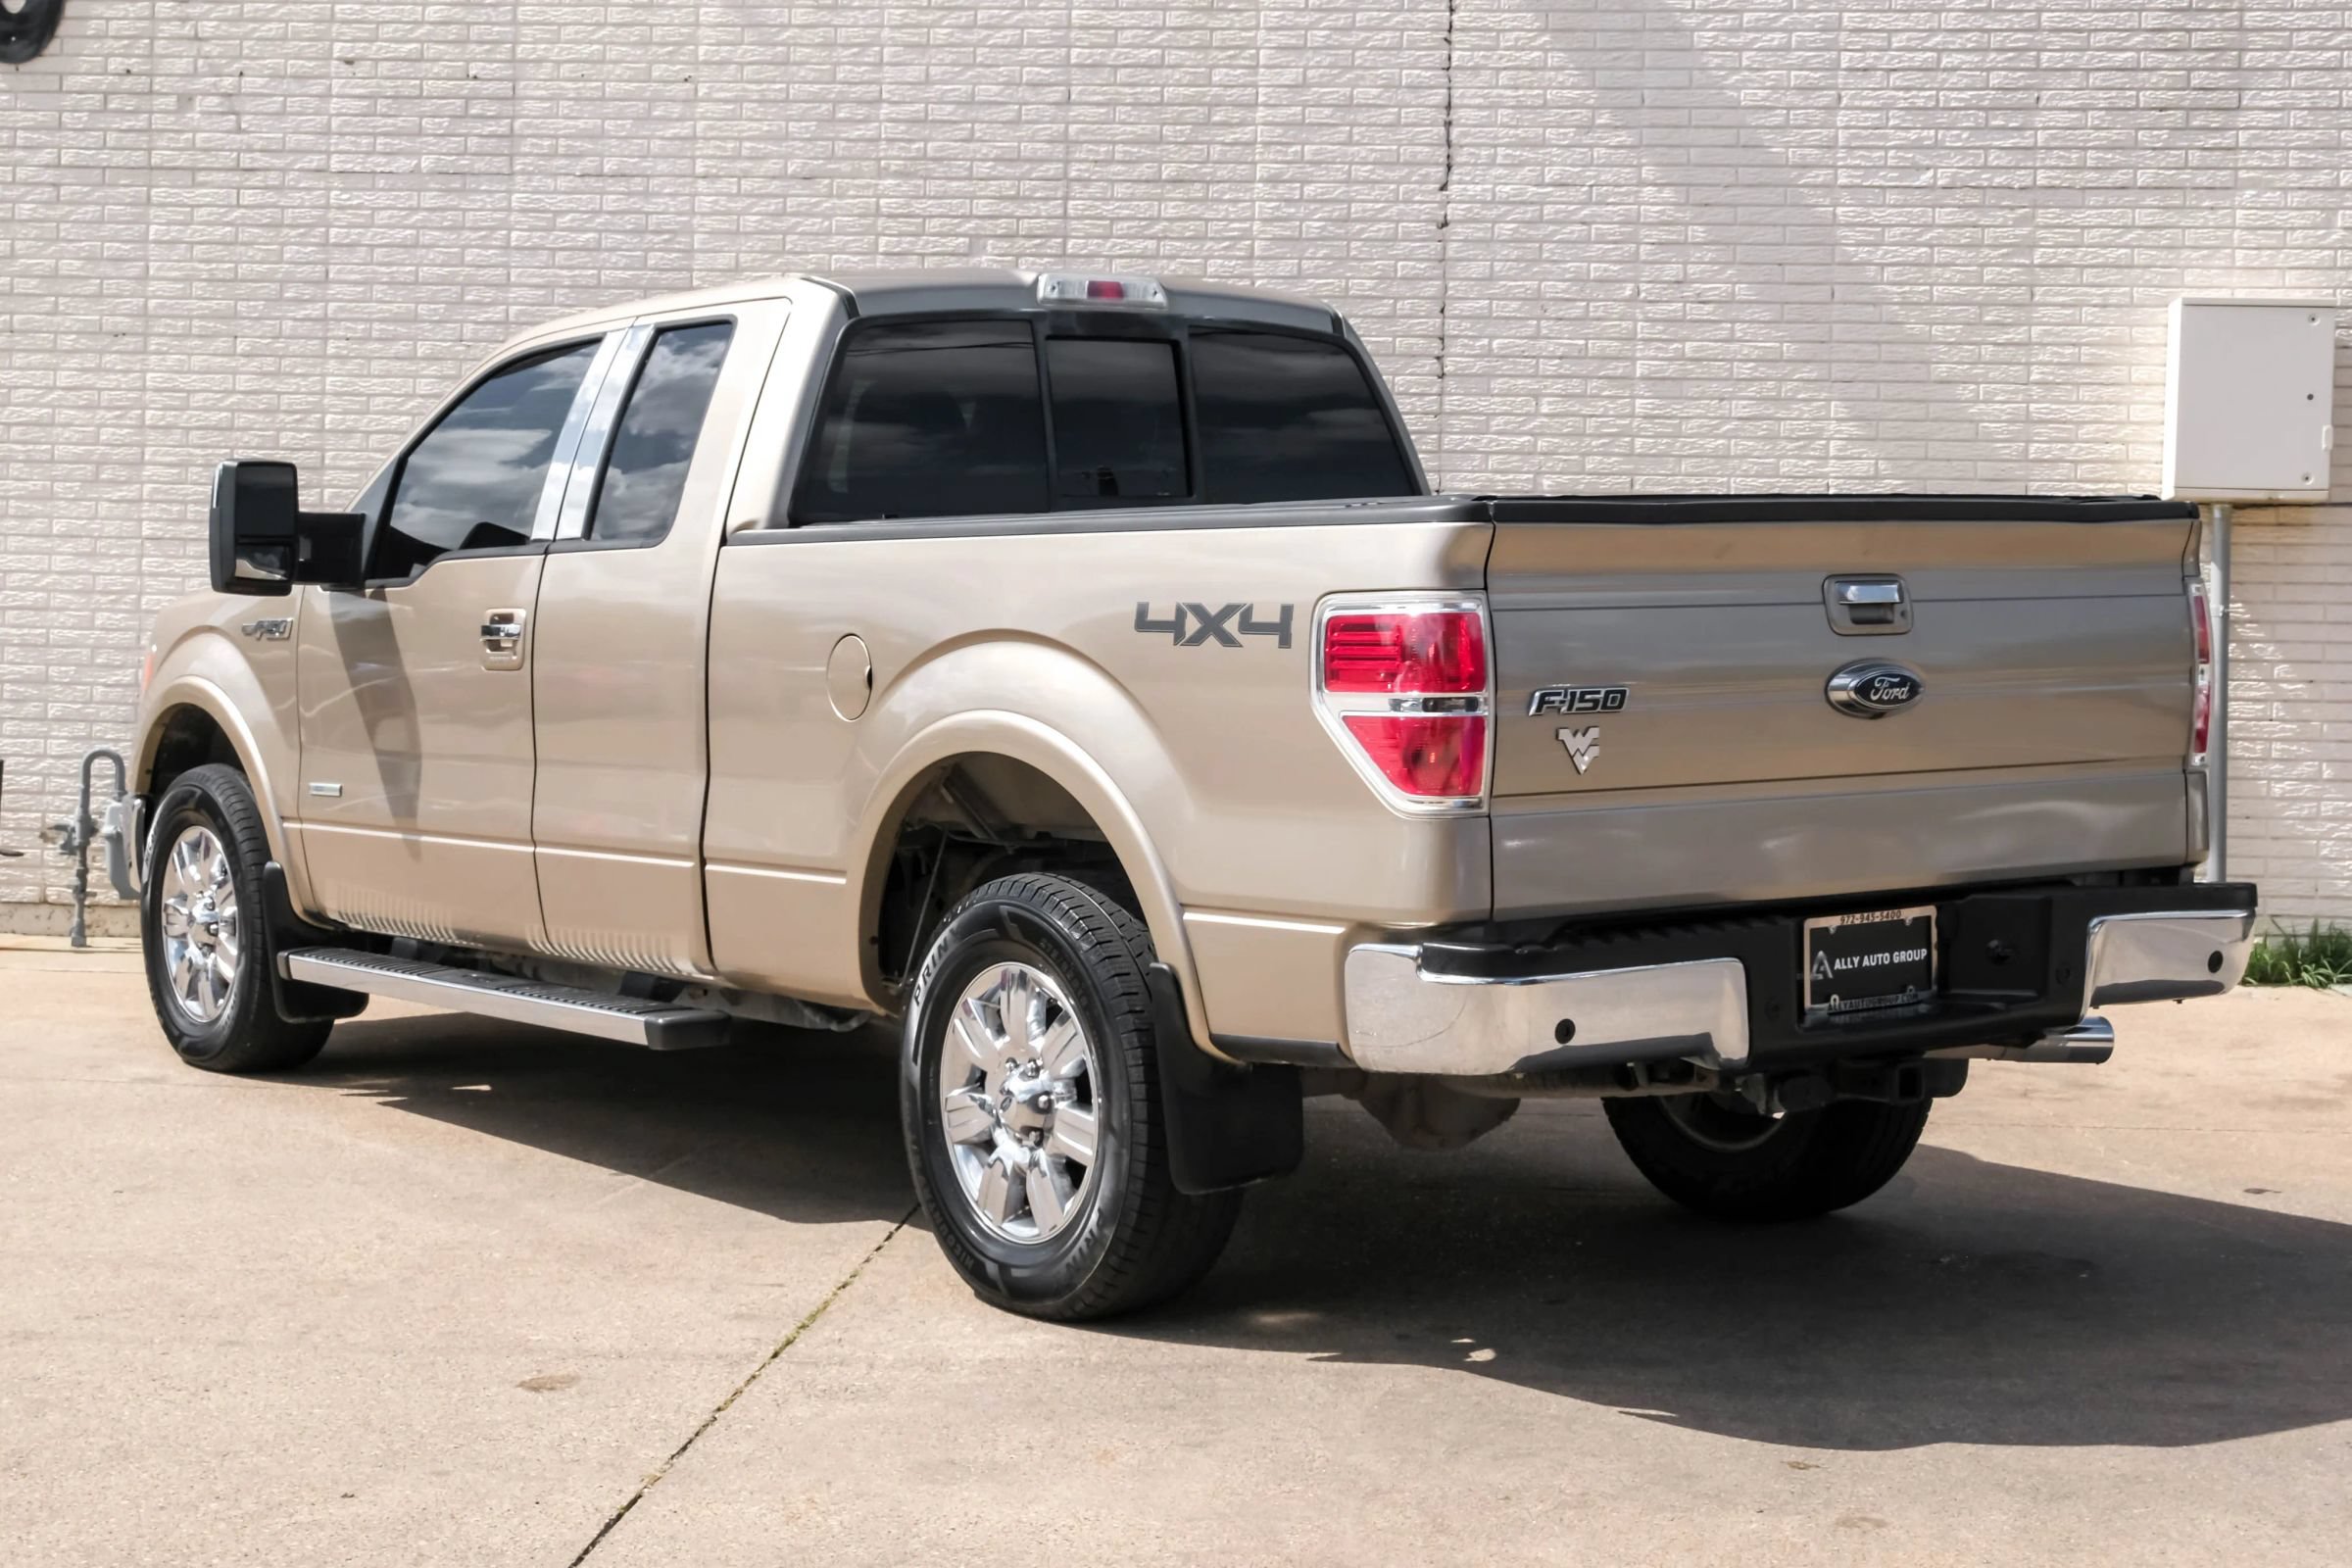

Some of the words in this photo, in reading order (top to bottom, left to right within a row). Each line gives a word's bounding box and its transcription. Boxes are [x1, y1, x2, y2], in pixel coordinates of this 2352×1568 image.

[1870, 676, 1910, 701] Ford
[1529, 687, 1630, 716] F-150
[1840, 909, 1902, 925] 972-945-5400
[1834, 956, 1860, 970] ALLY
[1862, 953, 1891, 967] AUTO
[1892, 948, 1928, 963] GROUP
